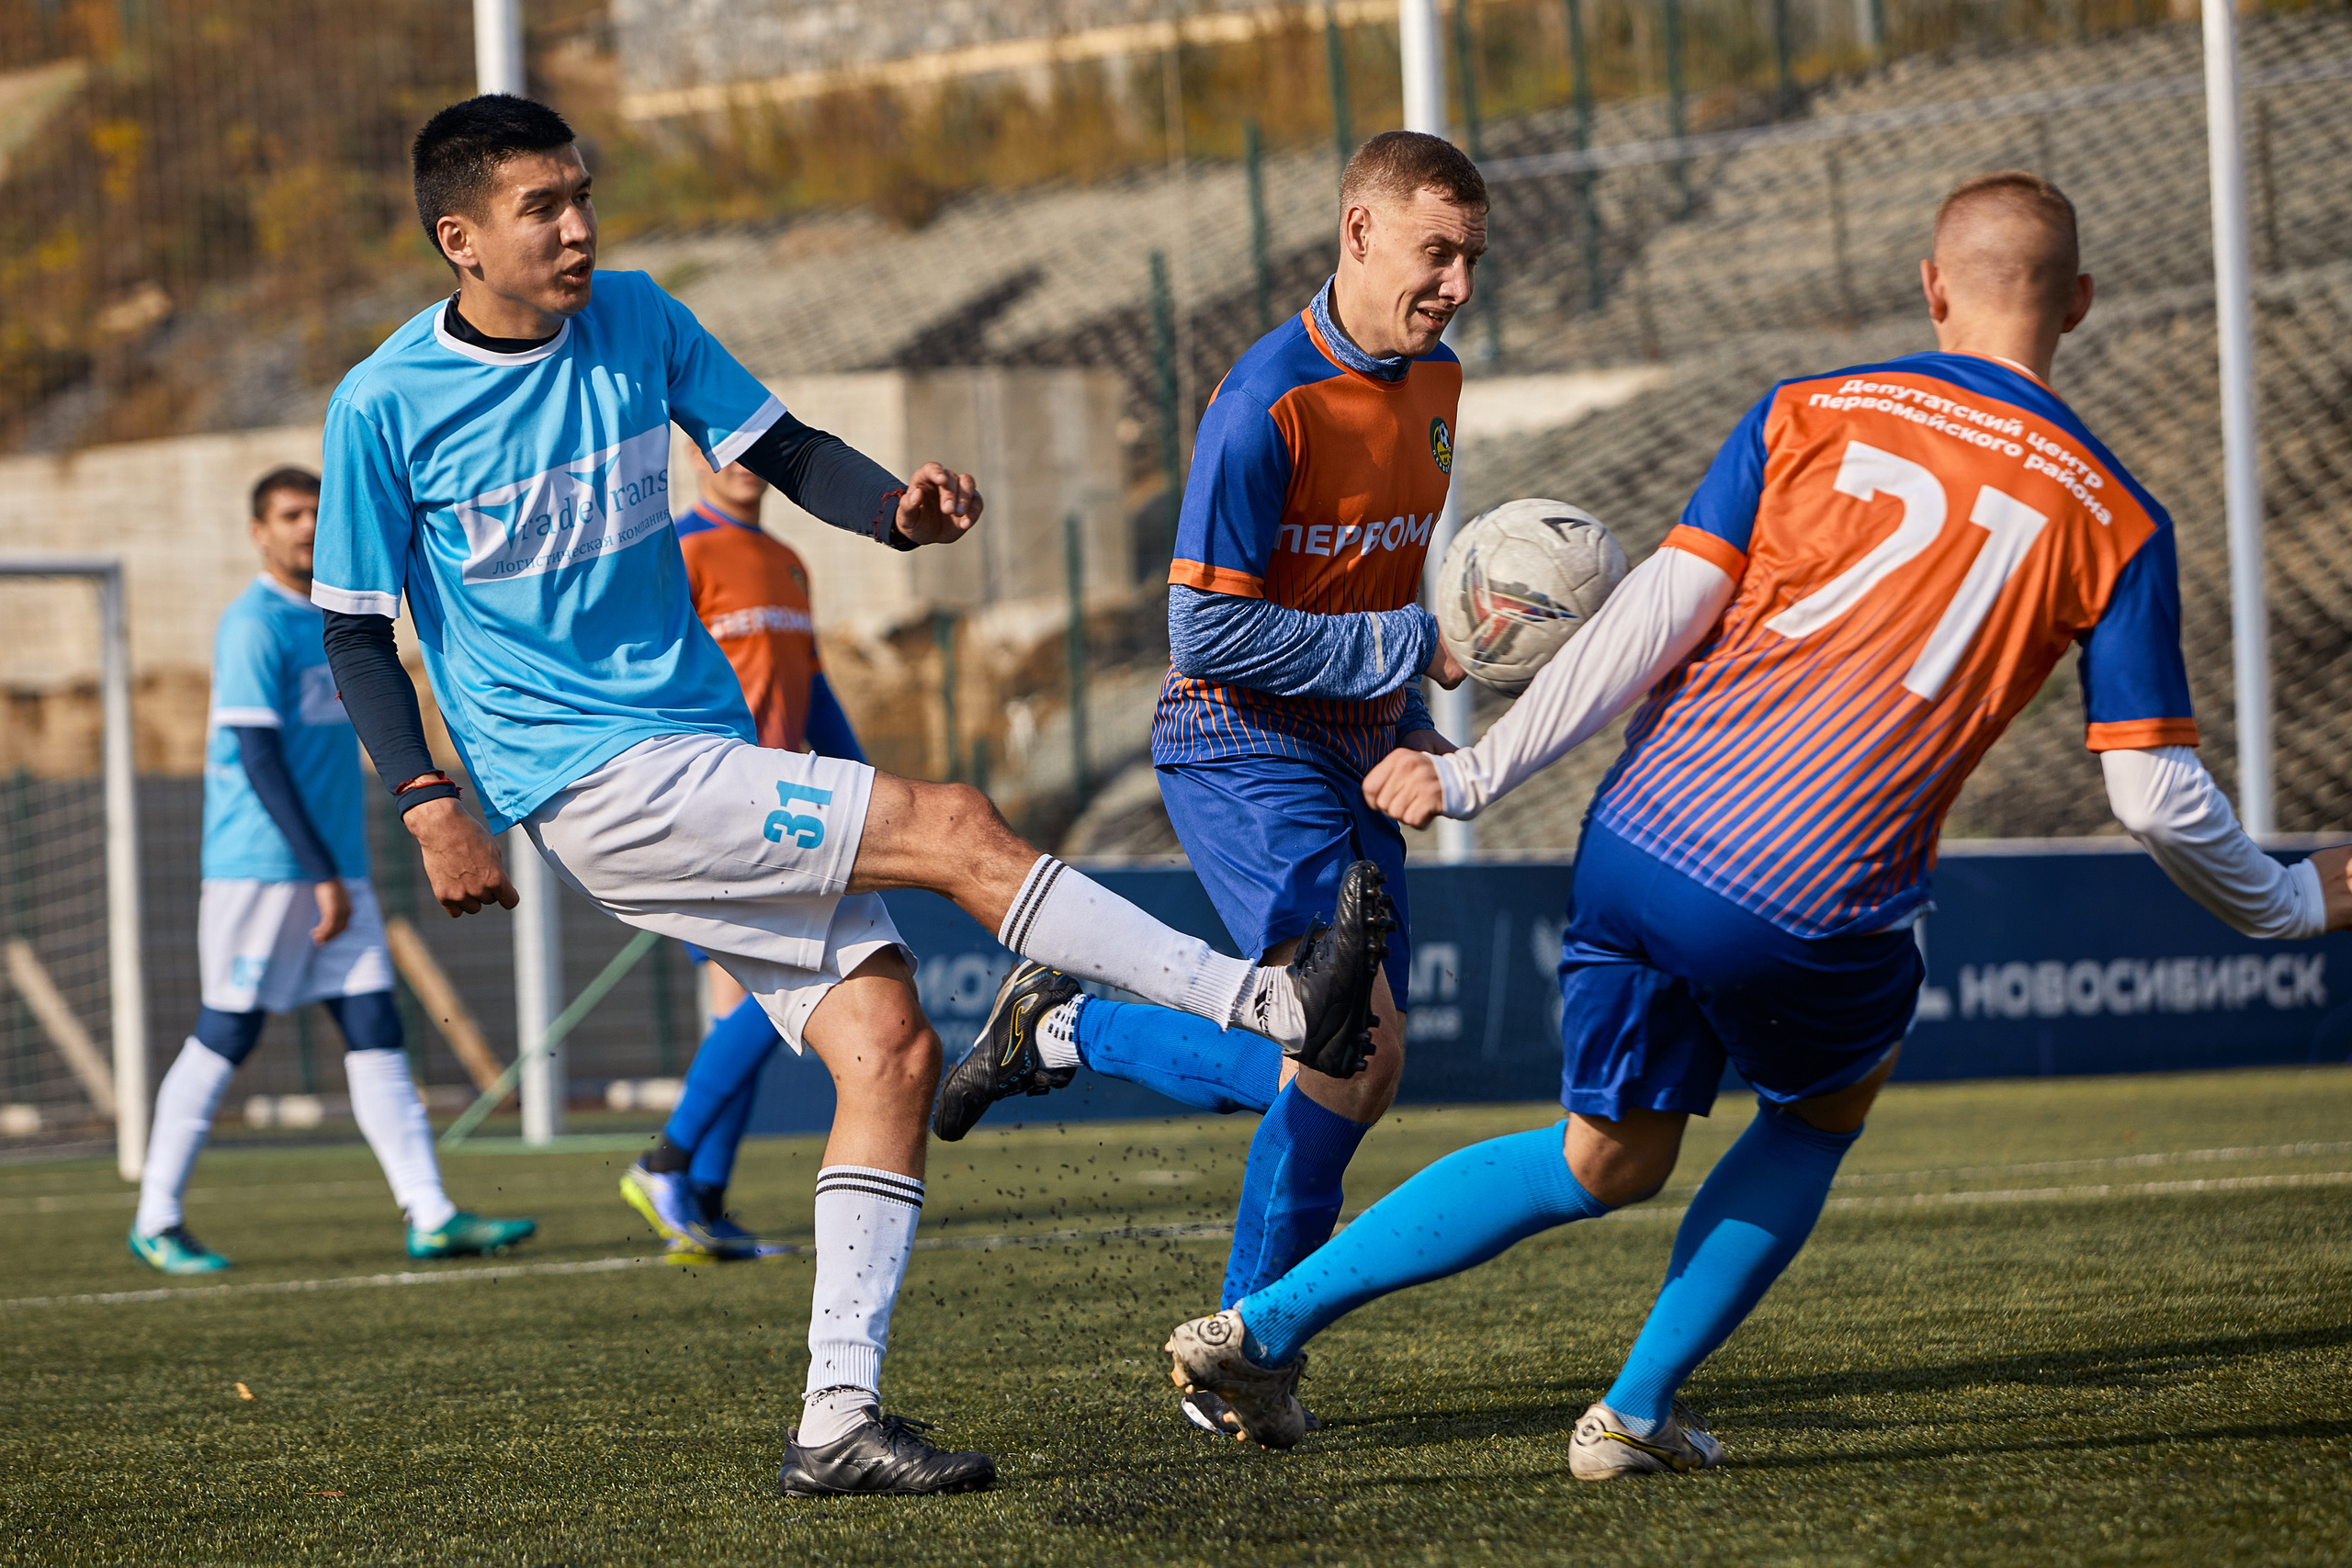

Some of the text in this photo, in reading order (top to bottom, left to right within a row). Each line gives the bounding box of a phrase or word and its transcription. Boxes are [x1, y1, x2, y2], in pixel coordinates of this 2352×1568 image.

[1808, 393, 2113, 527] Первомайского района
[1838, 379, 2104, 491] Депутатский центр
[492, 508, 670, 576] Логистическая компания
[1272, 511, 1442, 558] ПЕРВОМ
[1763, 439, 2050, 702] 21
[763, 779, 833, 850] 31
[1958, 952, 2327, 1020] НОВОСИБИРСК
